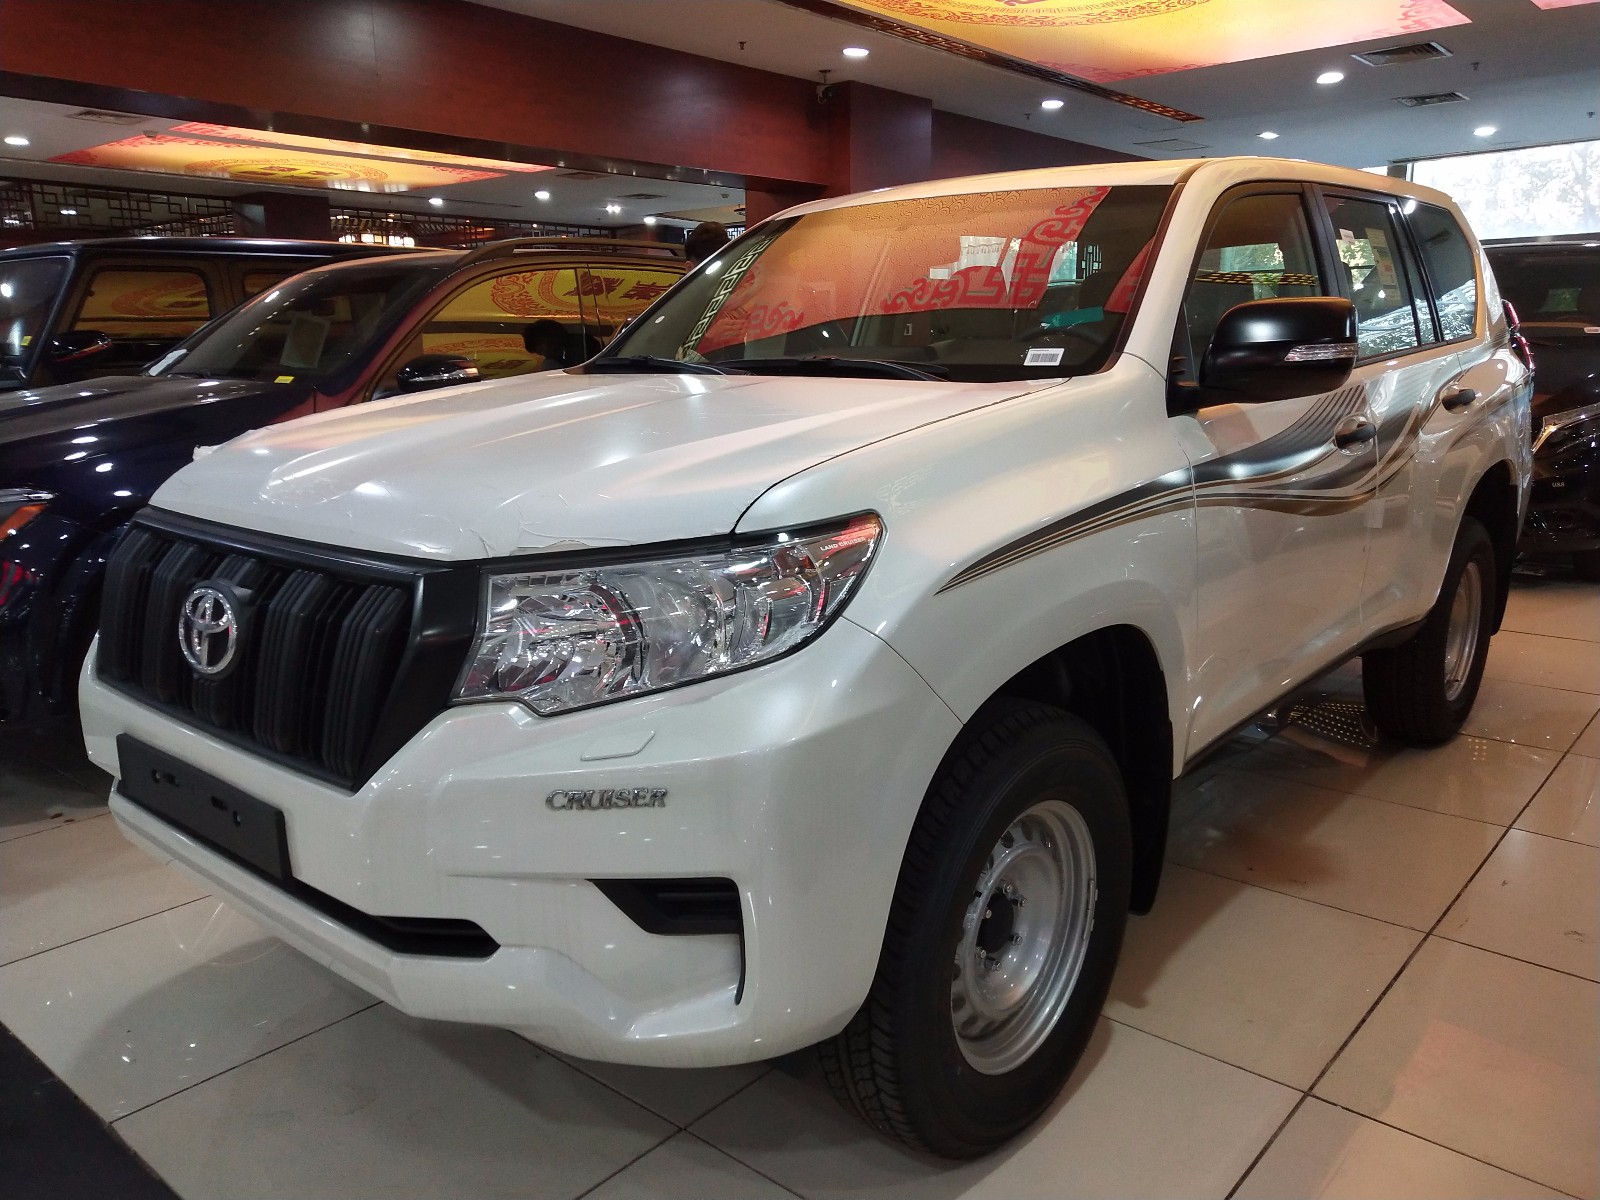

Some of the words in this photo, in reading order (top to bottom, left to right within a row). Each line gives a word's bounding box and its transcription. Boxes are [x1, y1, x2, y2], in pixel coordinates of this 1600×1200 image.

[820, 543, 839, 551] LAND
[838, 536, 866, 547] CRUISER
[545, 787, 668, 811] CRUISER
